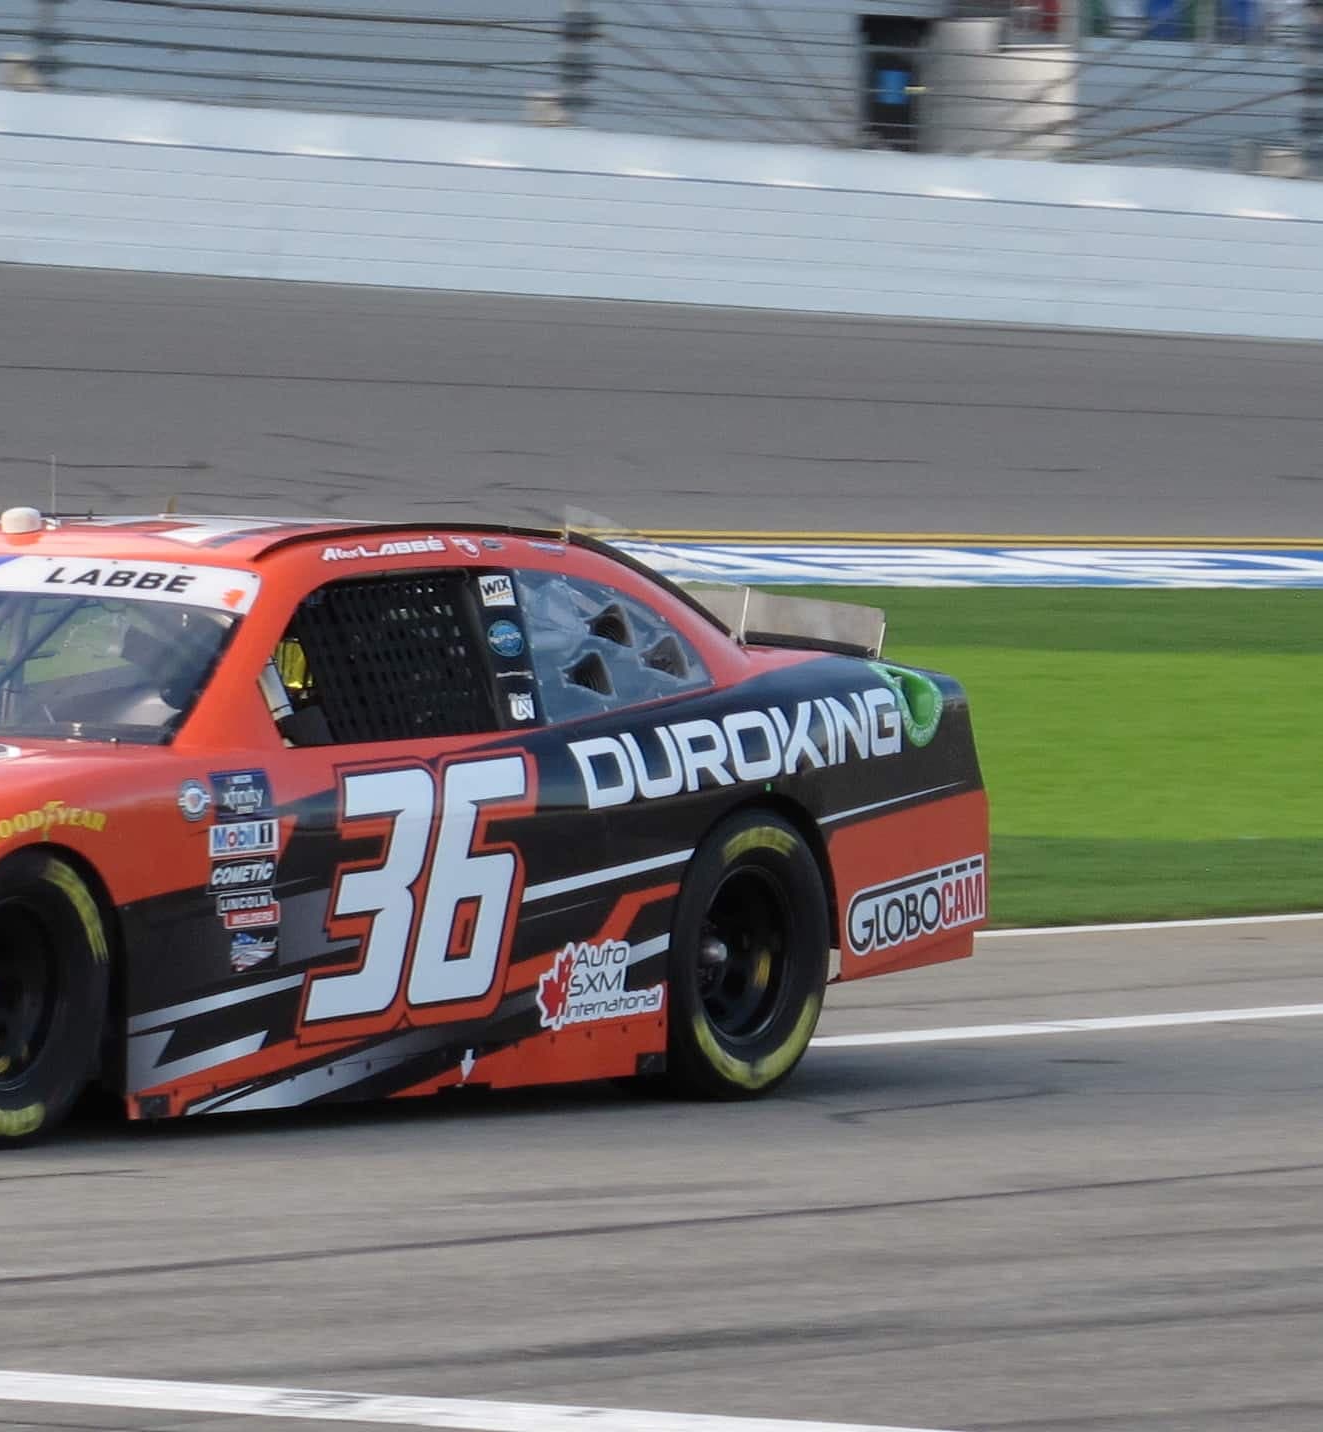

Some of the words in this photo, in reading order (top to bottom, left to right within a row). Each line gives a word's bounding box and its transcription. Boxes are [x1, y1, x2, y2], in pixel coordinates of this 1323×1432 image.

[482, 579, 510, 595] WIX
[567, 687, 902, 810] DUROKING
[304, 756, 526, 1022] 36
[847, 872, 985, 954] GLOBOCAM
[569, 969, 622, 997] SXM
[574, 945, 627, 970] Auto
